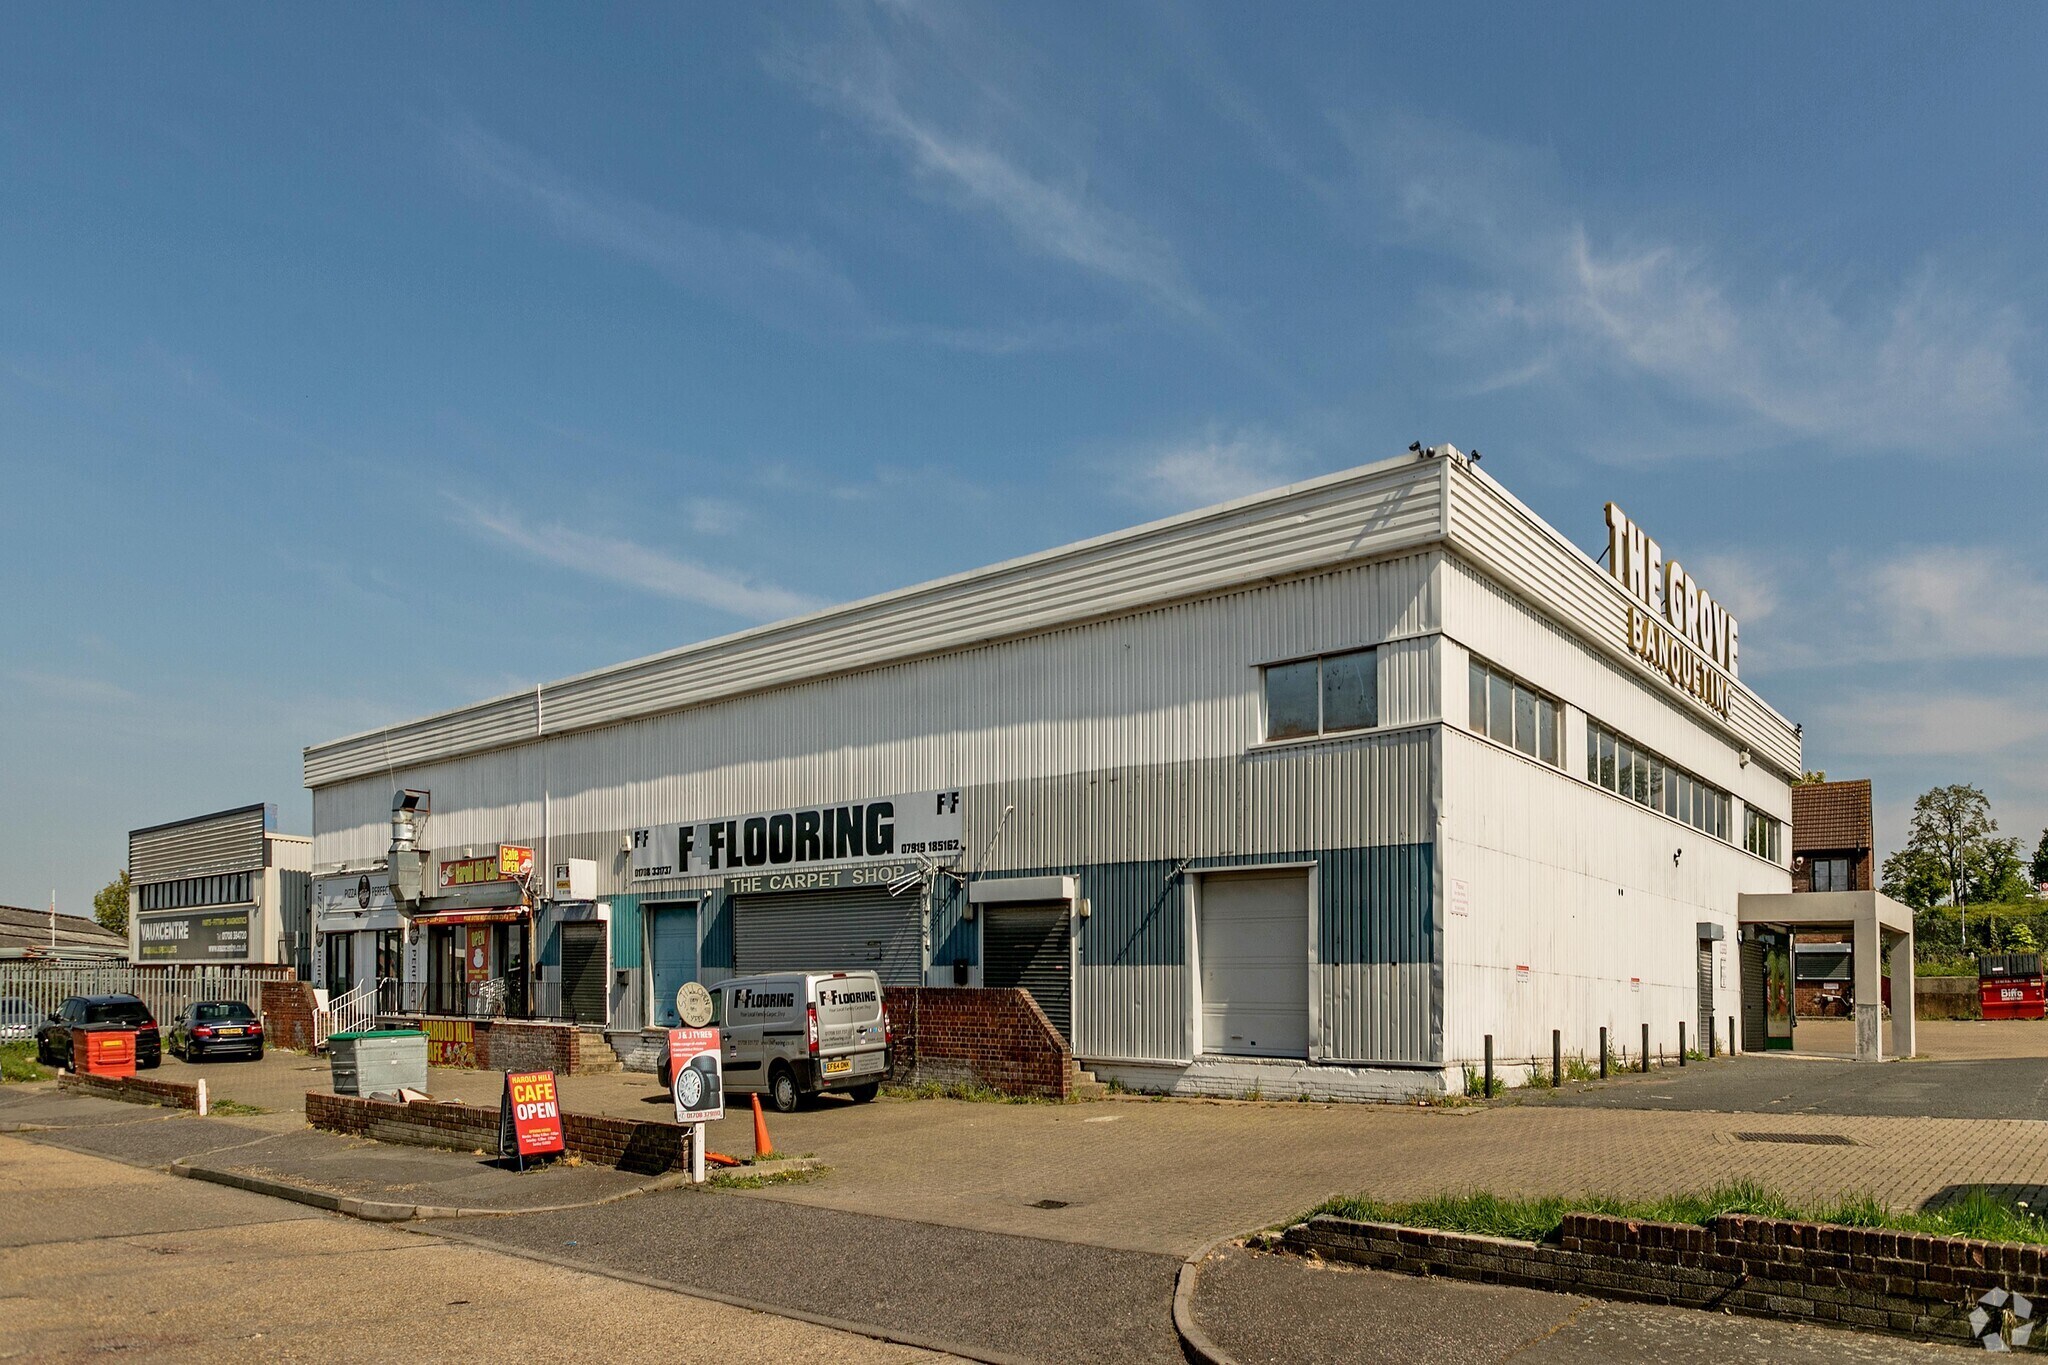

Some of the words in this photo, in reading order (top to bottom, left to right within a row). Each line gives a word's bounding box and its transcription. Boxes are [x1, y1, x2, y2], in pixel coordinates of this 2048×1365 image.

[1605, 502, 1662, 614] THE
[1665, 560, 1739, 679] GROVE
[1627, 606, 1733, 718] BANQUETING
[502, 847, 519, 861] Cafe
[901, 842, 926, 854] 07919
[928, 840, 959, 852] 185162
[502, 860, 520, 872] OPEN
[730, 878, 762, 894] THE
[769, 870, 842, 891] CARPET
[852, 864, 905, 883] SHOP
[344, 888, 357, 898] PIZZA
[141, 920, 189, 941] VAUXCENTRE
[2001, 987, 2024, 997] Biffa
[455, 1021, 473, 1041] HILL
[678, 1031, 682, 1040] J
[682, 1031, 687, 1039] &
[688, 1031, 693, 1040] J
[693, 1030, 713, 1039] TYRES
[427, 1042, 443, 1062] AFE
[511, 1075, 537, 1084] HAROLD
[538, 1074, 552, 1082] HILL
[514, 1083, 554, 1103] CAFE
[517, 1101, 556, 1121] OPEN
